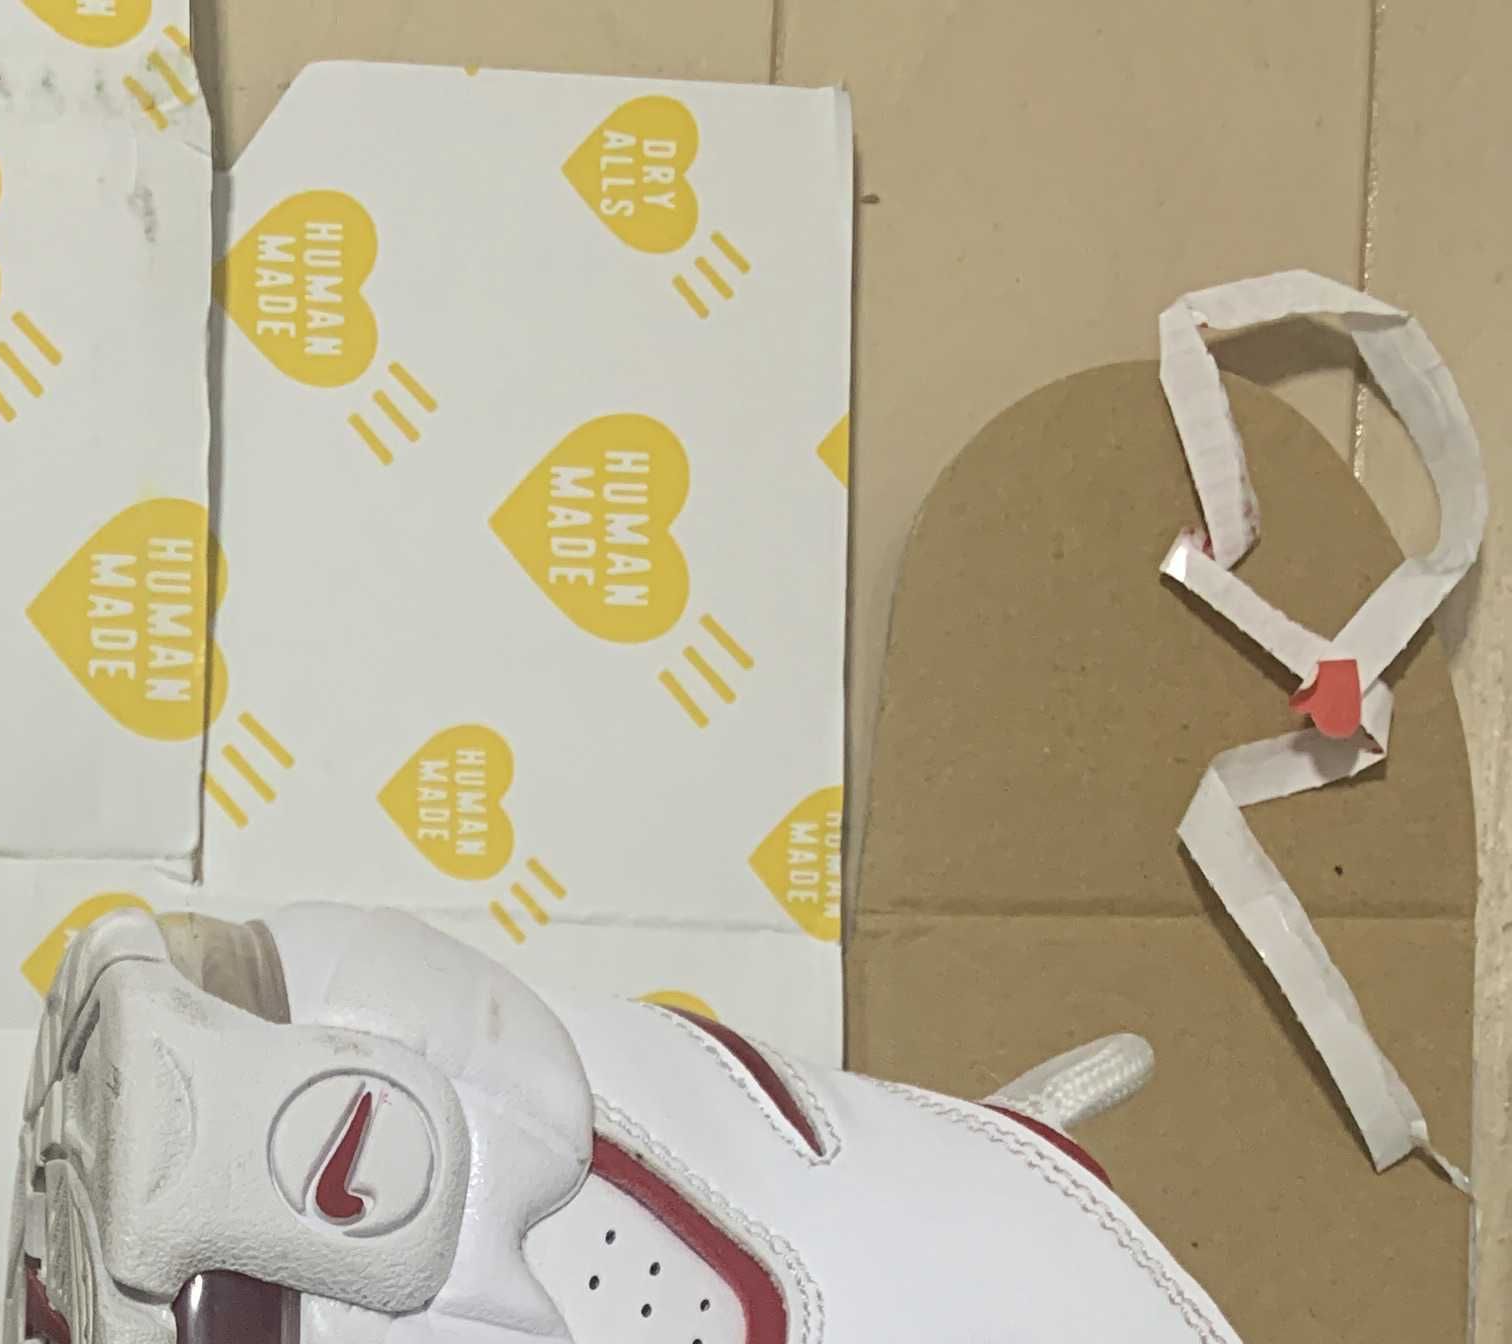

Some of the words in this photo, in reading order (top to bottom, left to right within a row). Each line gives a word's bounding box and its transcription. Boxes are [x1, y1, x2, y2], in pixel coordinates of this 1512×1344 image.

[598, 129, 635, 217] ALLS
[642, 138, 677, 209] DRY
[256, 232, 296, 336] MADE
[303, 222, 345, 355] HUMAN
[547, 465, 596, 586] MADE
[602, 450, 650, 606] HUMAN
[88, 552, 138, 677] MADE
[146, 538, 194, 702] HUMAN
[418, 759, 451, 838] MADE
[455, 749, 488, 855] HUMAN
[787, 820, 820, 901] MADE
